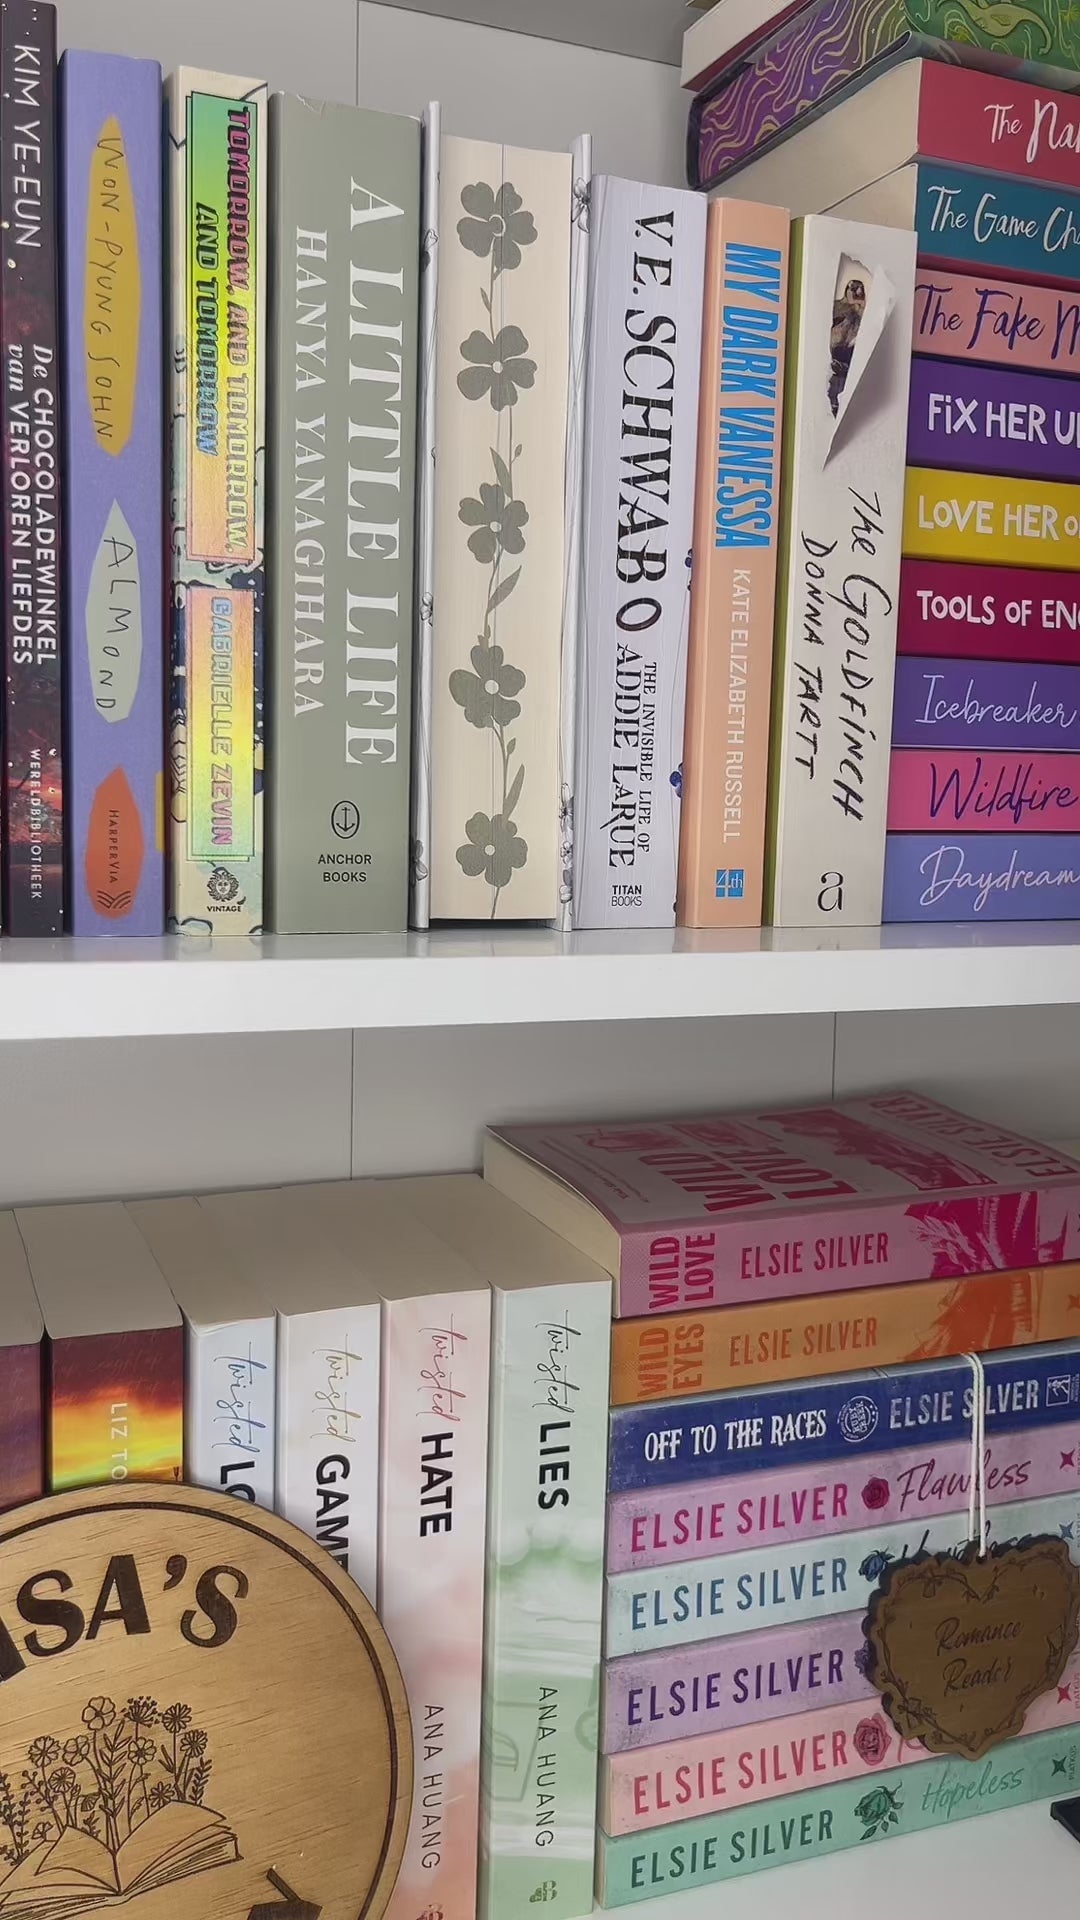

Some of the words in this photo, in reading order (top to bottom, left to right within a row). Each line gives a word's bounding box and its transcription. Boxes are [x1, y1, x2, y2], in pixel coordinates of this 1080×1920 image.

[14, 45, 40, 107] KIM
[984, 104, 1022, 144] The
[13, 121, 41, 248] YE-EUN
[351, 176, 405, 231] A
[928, 185, 969, 232] The
[974, 193, 1038, 243] Game
[196, 202, 219, 270] AND
[724, 242, 781, 303] MY
[228, 301, 249, 365] AND
[295, 226, 327, 392] HANYA
[915, 283, 964, 335] The
[966, 287, 1046, 350] Fake
[7, 344, 24, 392] van
[33, 344, 53, 378] De
[196, 276, 219, 456] TOMORROW
[721, 305, 780, 399] DARK
[88, 352, 120, 438] SOHN
[347, 260, 404, 560] LITTLE
[985, 401, 1048, 444] HER
[8, 401, 31, 545] VERLOREN
[616, 309, 677, 583] SCHWAB
[715, 407, 776, 549] VANESSA
[34, 387, 57, 665] CHOCOLADEWINKEL
[848, 486, 884, 556] The
[917, 496, 993, 535] LOVE
[1003, 503, 1060, 541] HER
[294, 413, 326, 717] YANAGIHARA
[732, 569, 751, 623] KATE
[801, 530, 838, 648] DONNA
[12, 557, 32, 665] LIEFDES
[96, 536, 138, 710] ALMOND
[916, 590, 996, 625] TOOLS
[1004, 600, 1032, 627] OF
[210, 597, 233, 757] GABRIELLE
[345, 587, 400, 765] LIFE
[614, 643, 643, 749] ADDIE
[644, 662, 657, 695] THE
[728, 630, 750, 746] ELIZABETH
[915, 674, 1078, 728] Icebreaker
[640, 704, 656, 782] INVISIBLE
[794, 661, 822, 781] TARTT
[29, 749, 42, 899] WERELDBIBLIOTHEEK
[210, 763, 233, 846] ZEVIN
[638, 790, 652, 825] LIFE
[723, 750, 746, 844] RUSSELL
[929, 757, 1080, 828] Wildfire
[317, 854, 372, 865] ANCHOR
[322, 871, 367, 883] BOOKS
[636, 832, 651, 853] OF
[207, 905, 242, 914] VINTAGE
[611, 895, 642, 907] BOOKS
[612, 884, 642, 895] TITAN
[649, 1235, 680, 1308] WILD
[684, 1232, 715, 1302] LOVE
[741, 1241, 804, 1280] ELSIE
[813, 1231, 889, 1272] SILVER
[415, 1313, 468, 1423] twisted
[532, 1309, 582, 1413] twisted
[638, 1327, 670, 1397] WILD
[672, 1322, 705, 1391] EYES
[729, 1330, 792, 1367] ELSIE
[802, 1316, 878, 1357] SILVER
[111, 1403, 128, 1439] LIZ
[212, 1342, 267, 1453] twisted
[310, 1334, 363, 1443] twisted
[890, 1391, 953, 1430] ELSIE
[962, 1379, 1039, 1420] SLVER
[538, 1421, 571, 1510] LIES
[645, 1429, 682, 1462] OFF
[692, 1425, 717, 1454] TO
[724, 1416, 762, 1450] THE
[771, 1409, 827, 1446] RACES
[419, 1432, 454, 1537] HATE
[631, 1503, 725, 1553] ELSIE
[737, 1483, 848, 1534] SILVER
[632, 1578, 725, 1631] ELSIE
[737, 1557, 847, 1610] SILVER
[935, 1617, 1023, 1656] Romance
[538, 1687, 559, 1741] ANA
[628, 1672, 721, 1726] ELSIE
[732, 1648, 844, 1703] SILVER
[424, 1704, 444, 1761] ANA
[535, 1754, 557, 1847] HUANG
[634, 1757, 727, 1815] ELSIE
[738, 1730, 849, 1789] SILVER
[923, 1760, 1026, 1820] Hopeless
[421, 1773, 443, 1869] HUANG
[631, 1837, 718, 1888] ELSIE
[730, 1809, 834, 1863] SILVER
